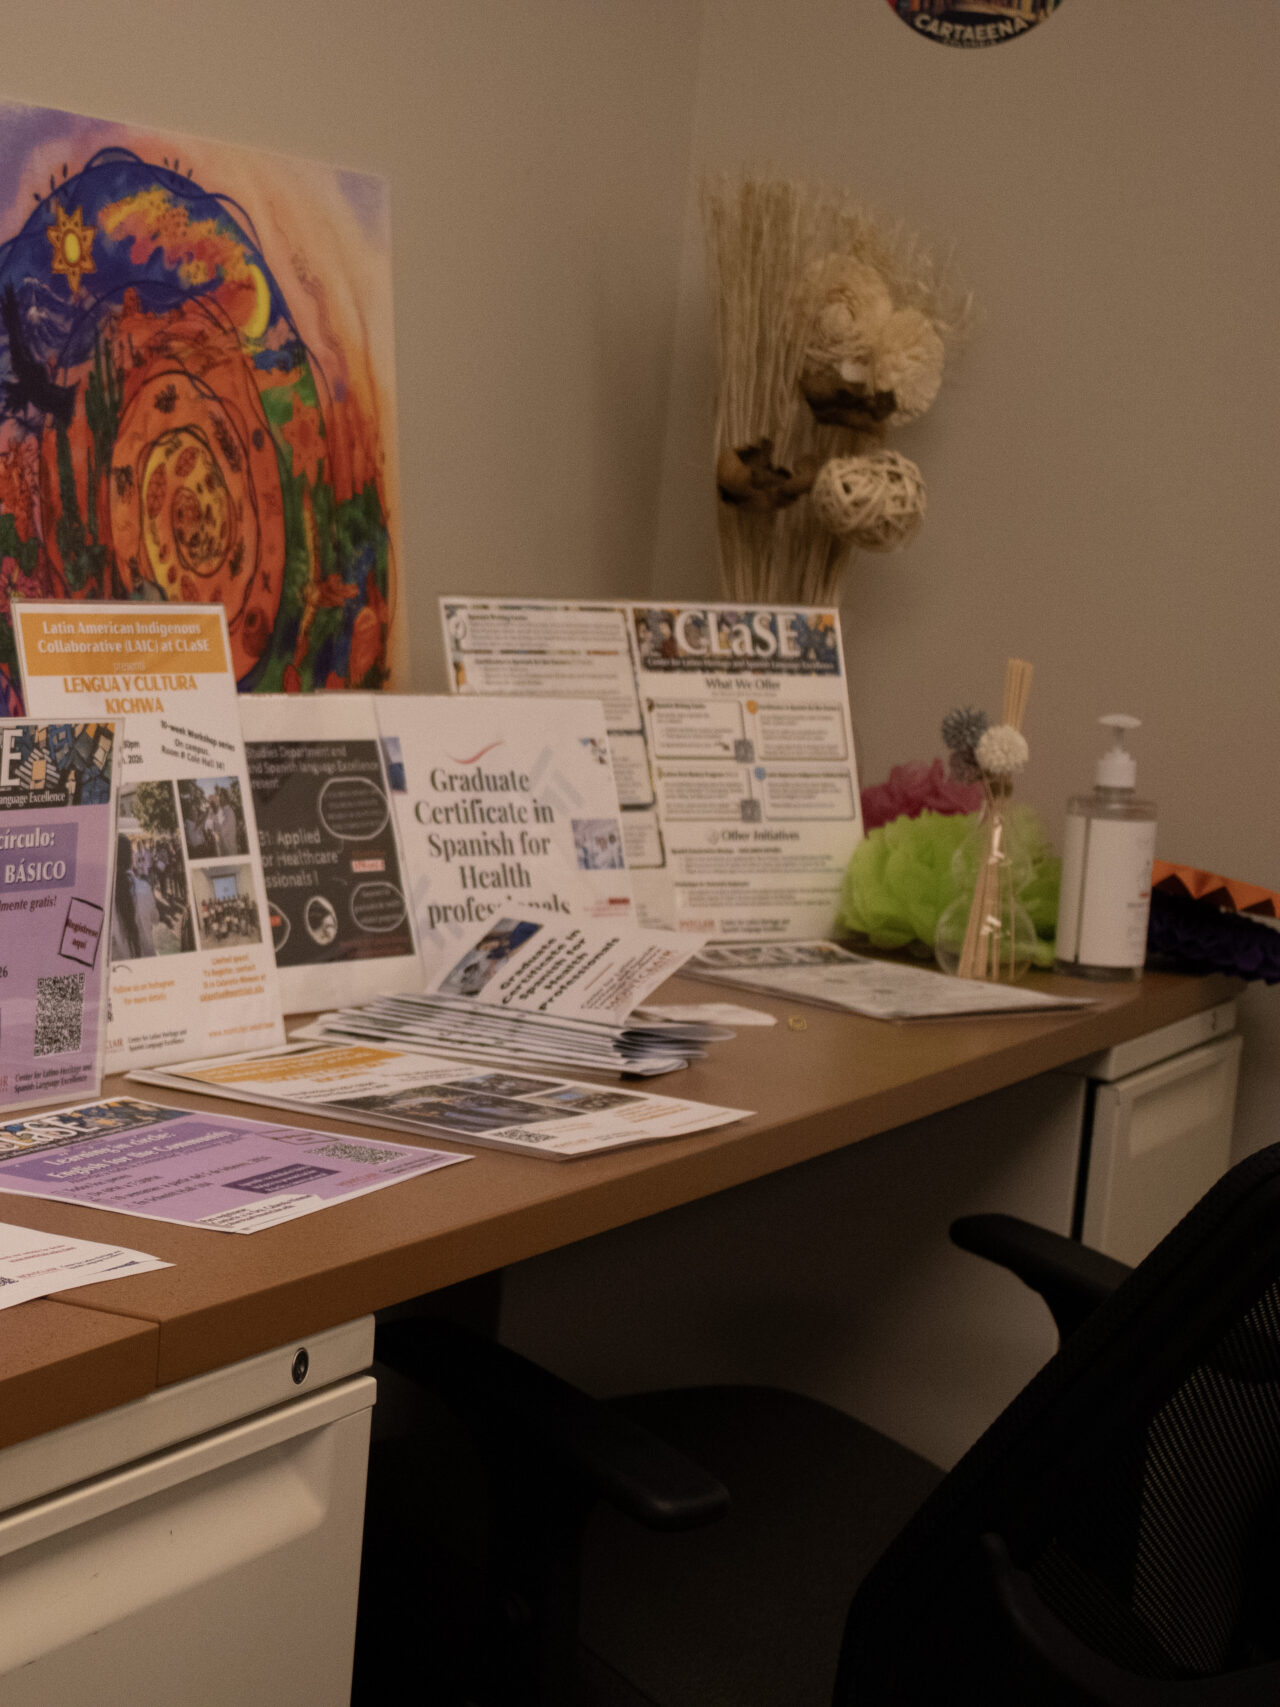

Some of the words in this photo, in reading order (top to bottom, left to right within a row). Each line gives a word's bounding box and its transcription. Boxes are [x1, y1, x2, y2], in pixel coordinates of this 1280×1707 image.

[41, 620, 75, 634] Latin
[77, 621, 134, 634] American
[135, 621, 201, 637] Indigenous
[675, 609, 802, 658] CLaSE
[63, 676, 121, 694] LENGUA
[122, 676, 133, 692] Y
[134, 675, 199, 692] CULTURA
[705, 678, 735, 691] What
[735, 678, 751, 691] We
[753, 678, 781, 691] Offer
[105, 697, 165, 715] KICHWA
[430, 767, 531, 793] Graduate
[415, 799, 529, 825] Certificate
[533, 799, 555, 824] in
[427, 830, 516, 863] Spanish
[519, 831, 552, 856] for
[721, 828, 756, 842] Other
[758, 829, 800, 844] Initiatives
[4, 860, 66, 883] BÁSICO
[459, 863, 532, 890] Health
